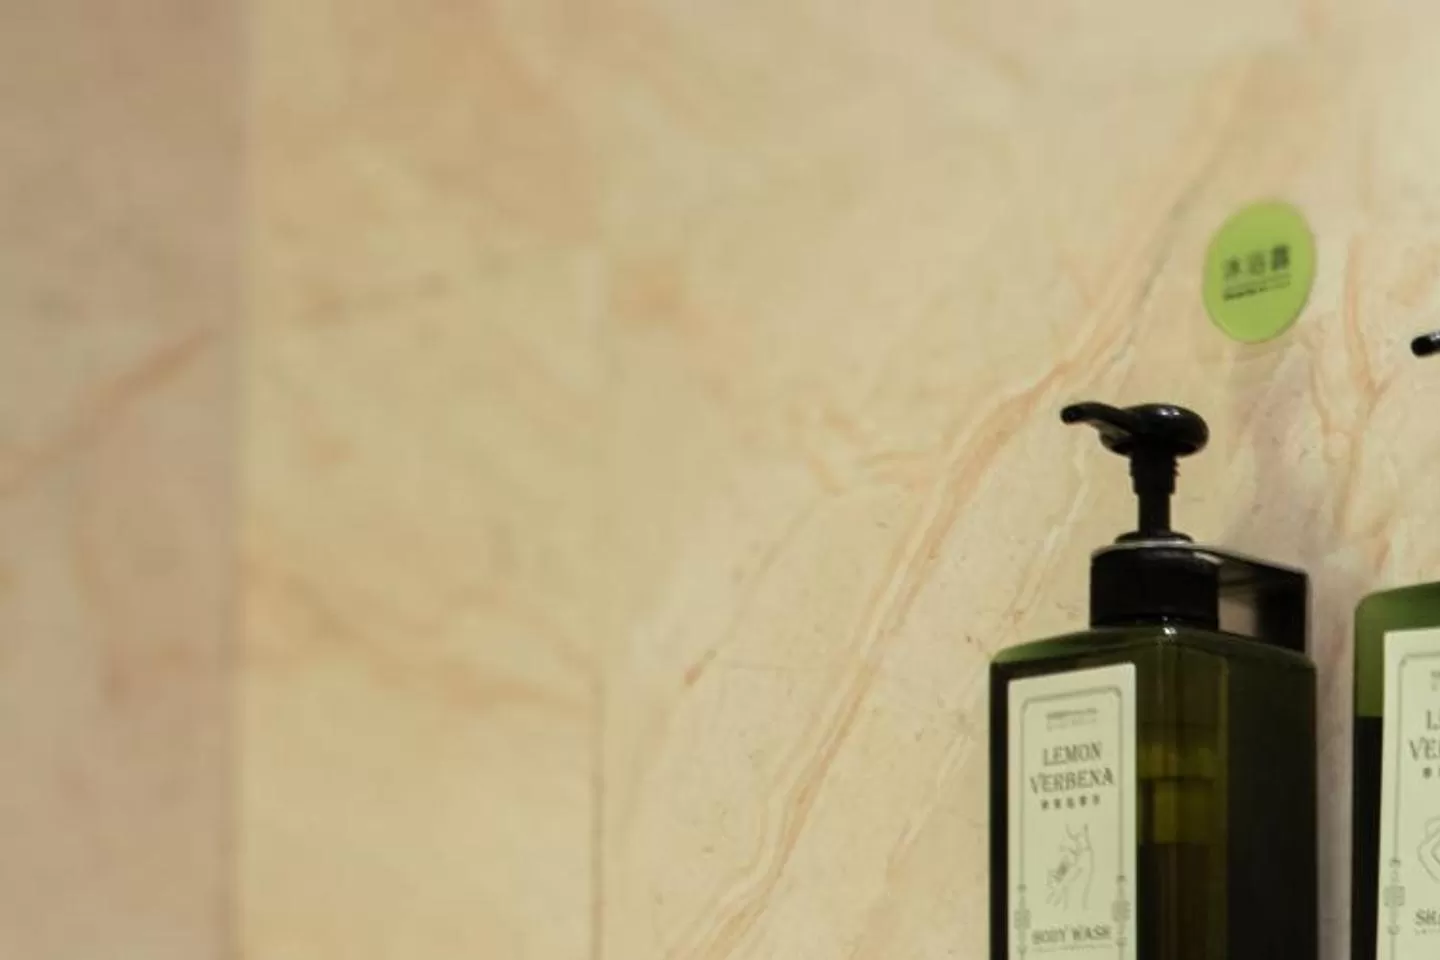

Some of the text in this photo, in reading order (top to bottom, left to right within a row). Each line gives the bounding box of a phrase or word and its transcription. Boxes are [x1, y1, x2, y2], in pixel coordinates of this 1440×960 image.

[1042, 741, 1102, 766] LEMON
[1028, 766, 1116, 794] VERBENA
[1031, 922, 1112, 945] BODY WASH
